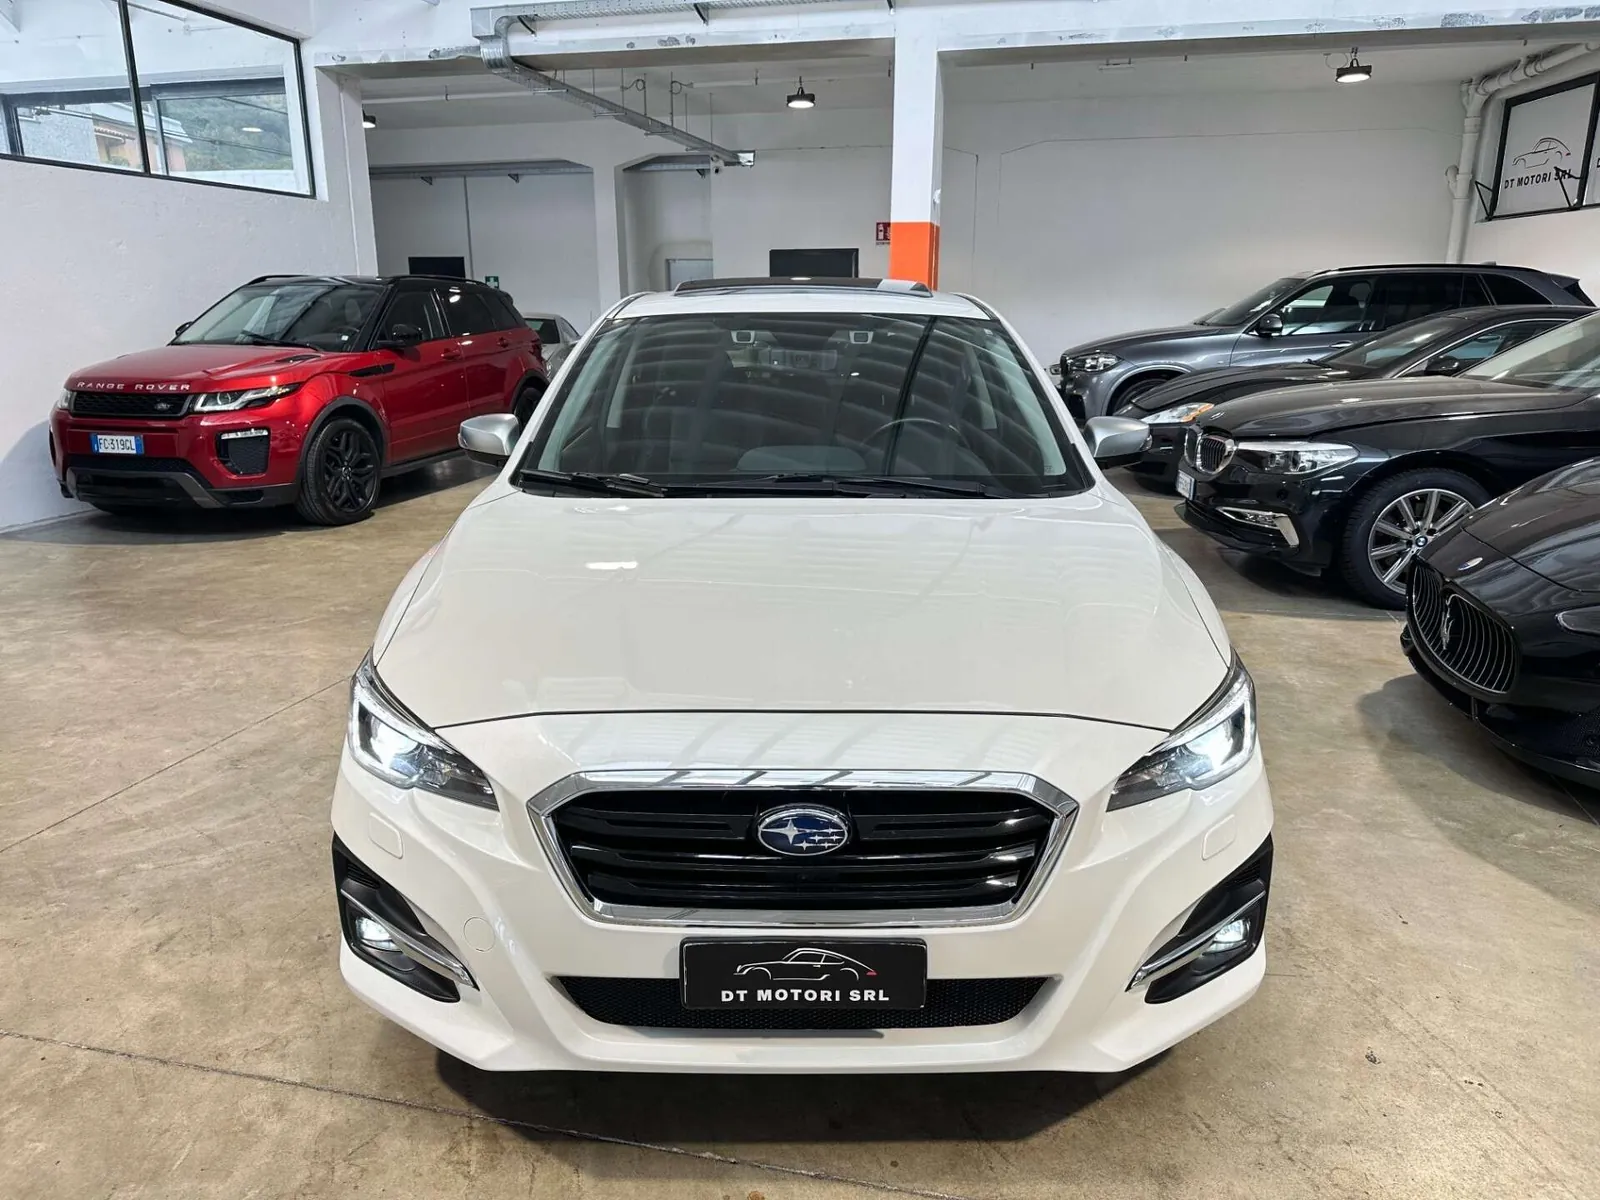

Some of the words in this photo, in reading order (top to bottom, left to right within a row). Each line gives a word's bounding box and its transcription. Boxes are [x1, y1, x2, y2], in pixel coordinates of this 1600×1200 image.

[1504, 178, 1514, 189] DT
[1516, 172, 1552, 188] MOTORI
[77, 381, 125, 390] RANGE
[134, 383, 191, 391] ROVER
[721, 990, 748, 1002] DT
[756, 989, 841, 1002] MOTORI
[849, 989, 890, 1002] SRL
